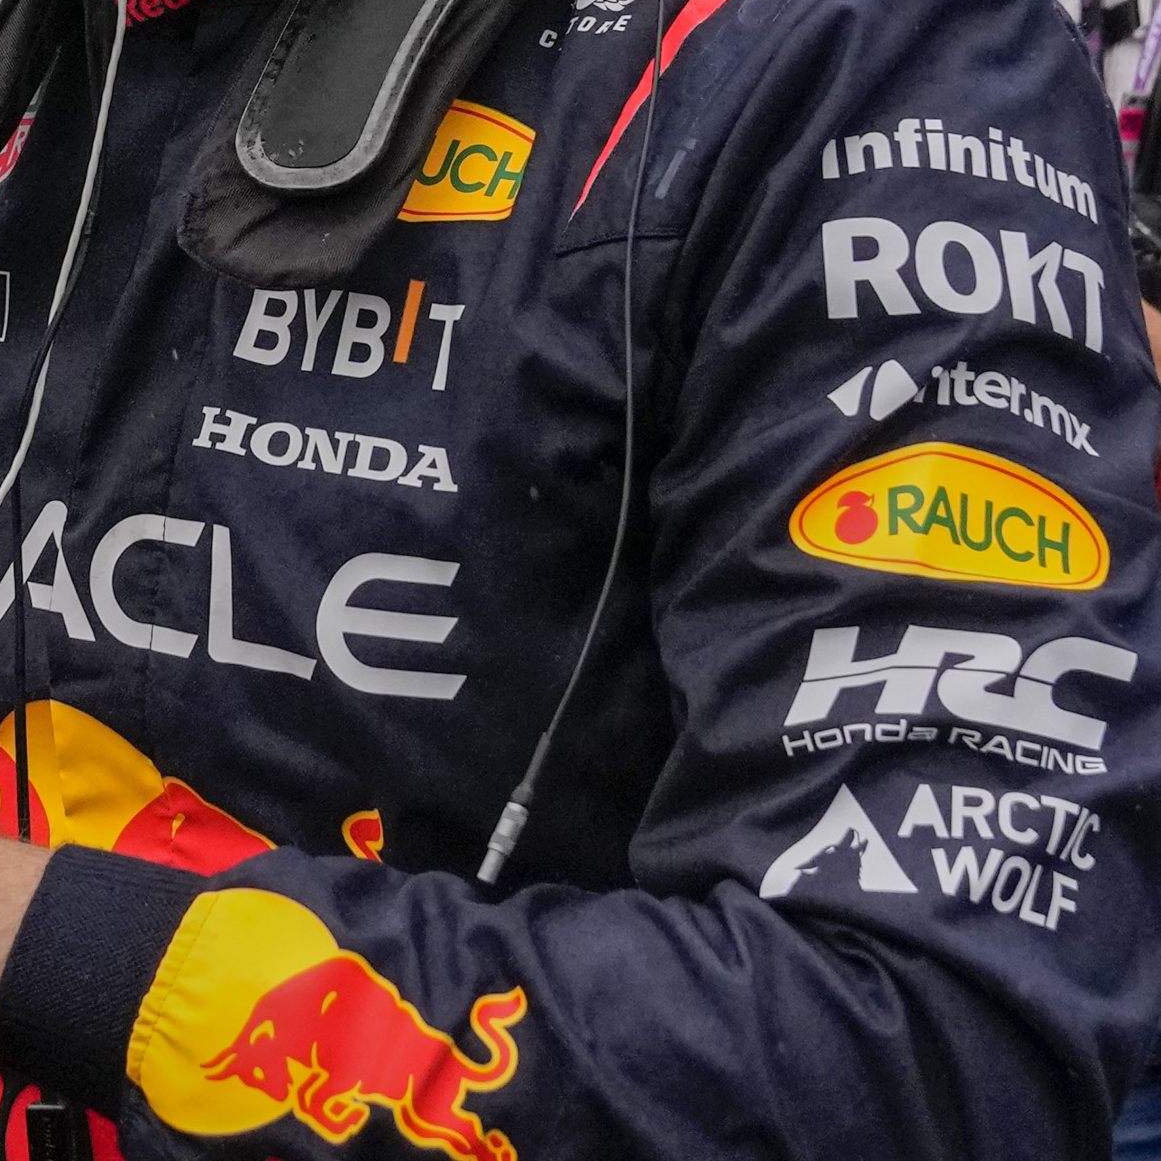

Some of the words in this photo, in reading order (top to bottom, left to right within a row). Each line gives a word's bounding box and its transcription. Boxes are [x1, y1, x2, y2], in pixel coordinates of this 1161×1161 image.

[416, 139, 526, 200] UCH
[821, 216, 1105, 354] ROKT
[232, 279, 465, 391] BYBIT
[191, 406, 459, 493] HONDA
[887, 484, 1072, 575] RAUCH
[781, 719, 939, 757] Honda
[948, 726, 1108, 776] RACING
[897, 783, 1101, 872] ARCTIC
[930, 845, 1080, 932] WOLF
